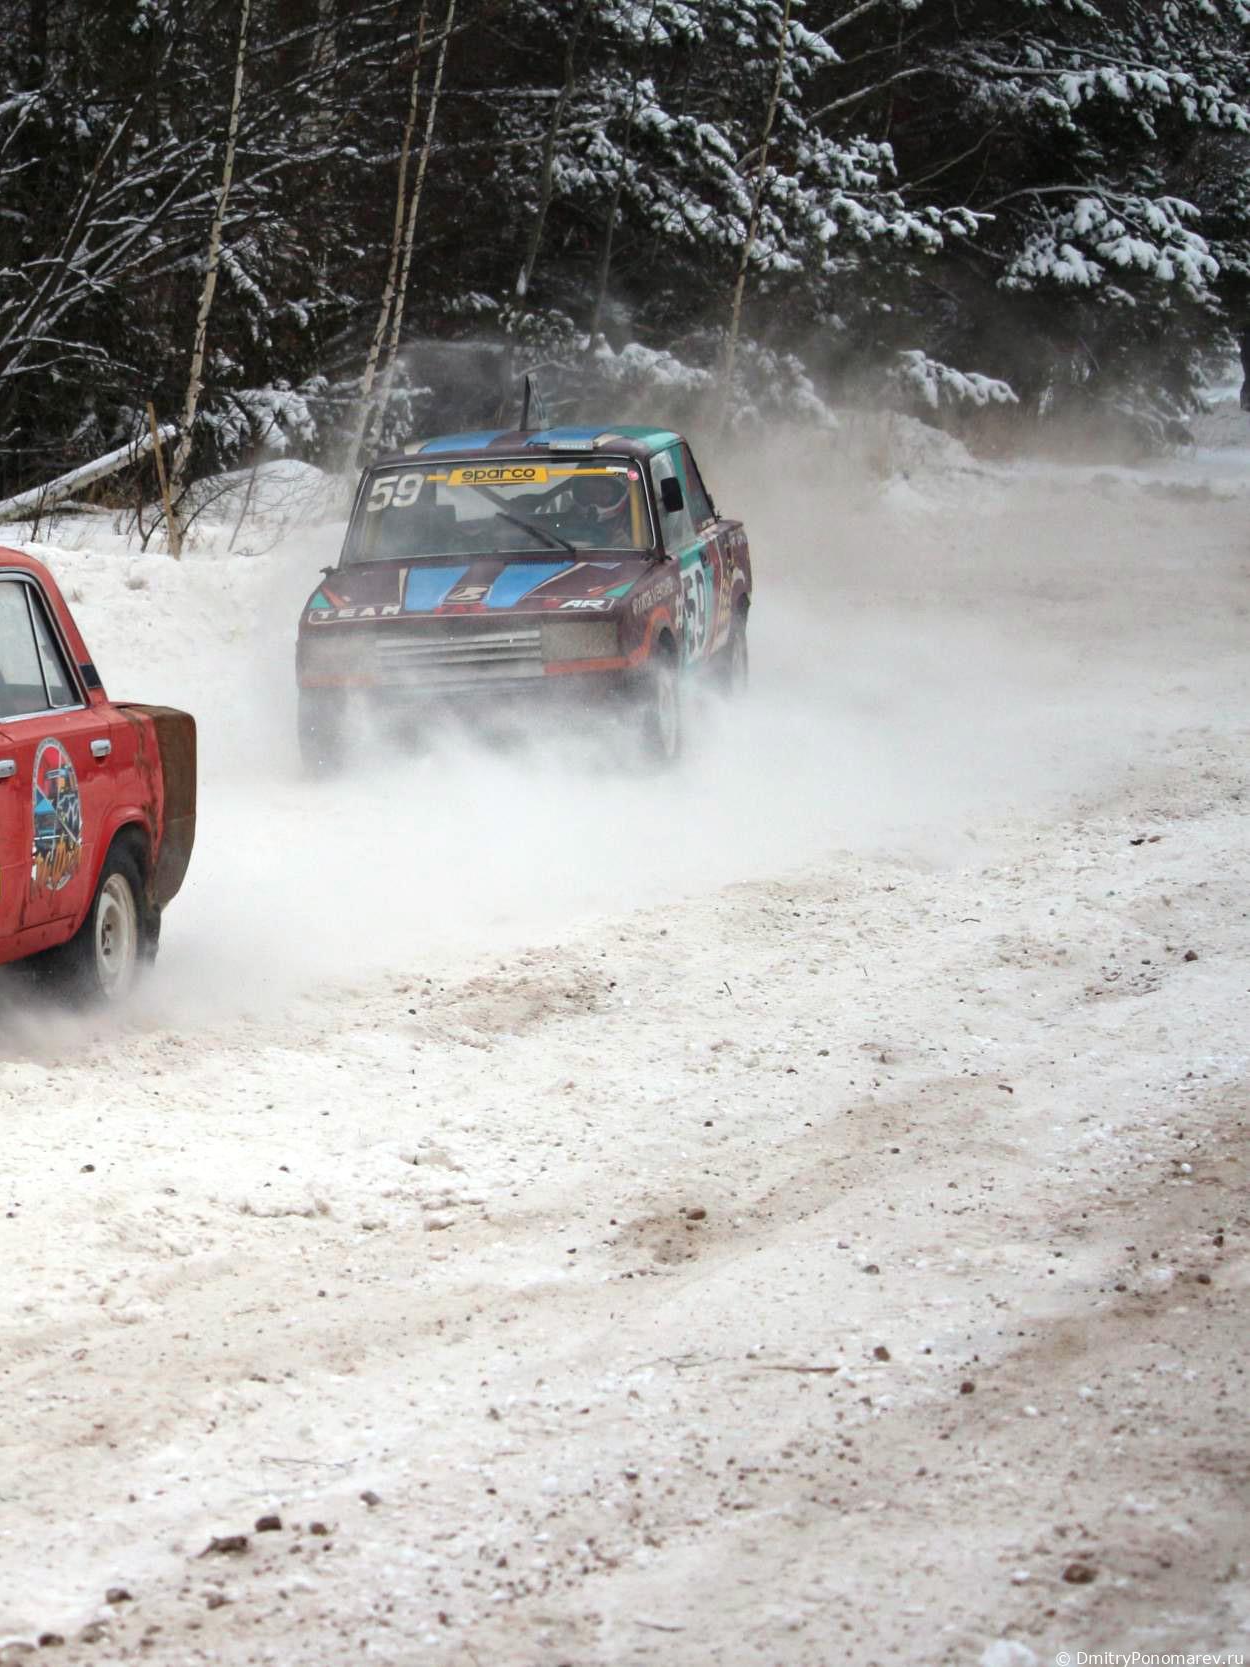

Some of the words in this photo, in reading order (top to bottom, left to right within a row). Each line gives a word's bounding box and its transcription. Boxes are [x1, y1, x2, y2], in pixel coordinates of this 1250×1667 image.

[461, 467, 536, 483] sparco
[366, 473, 426, 512] 59
[317, 605, 401, 619] TEAM
